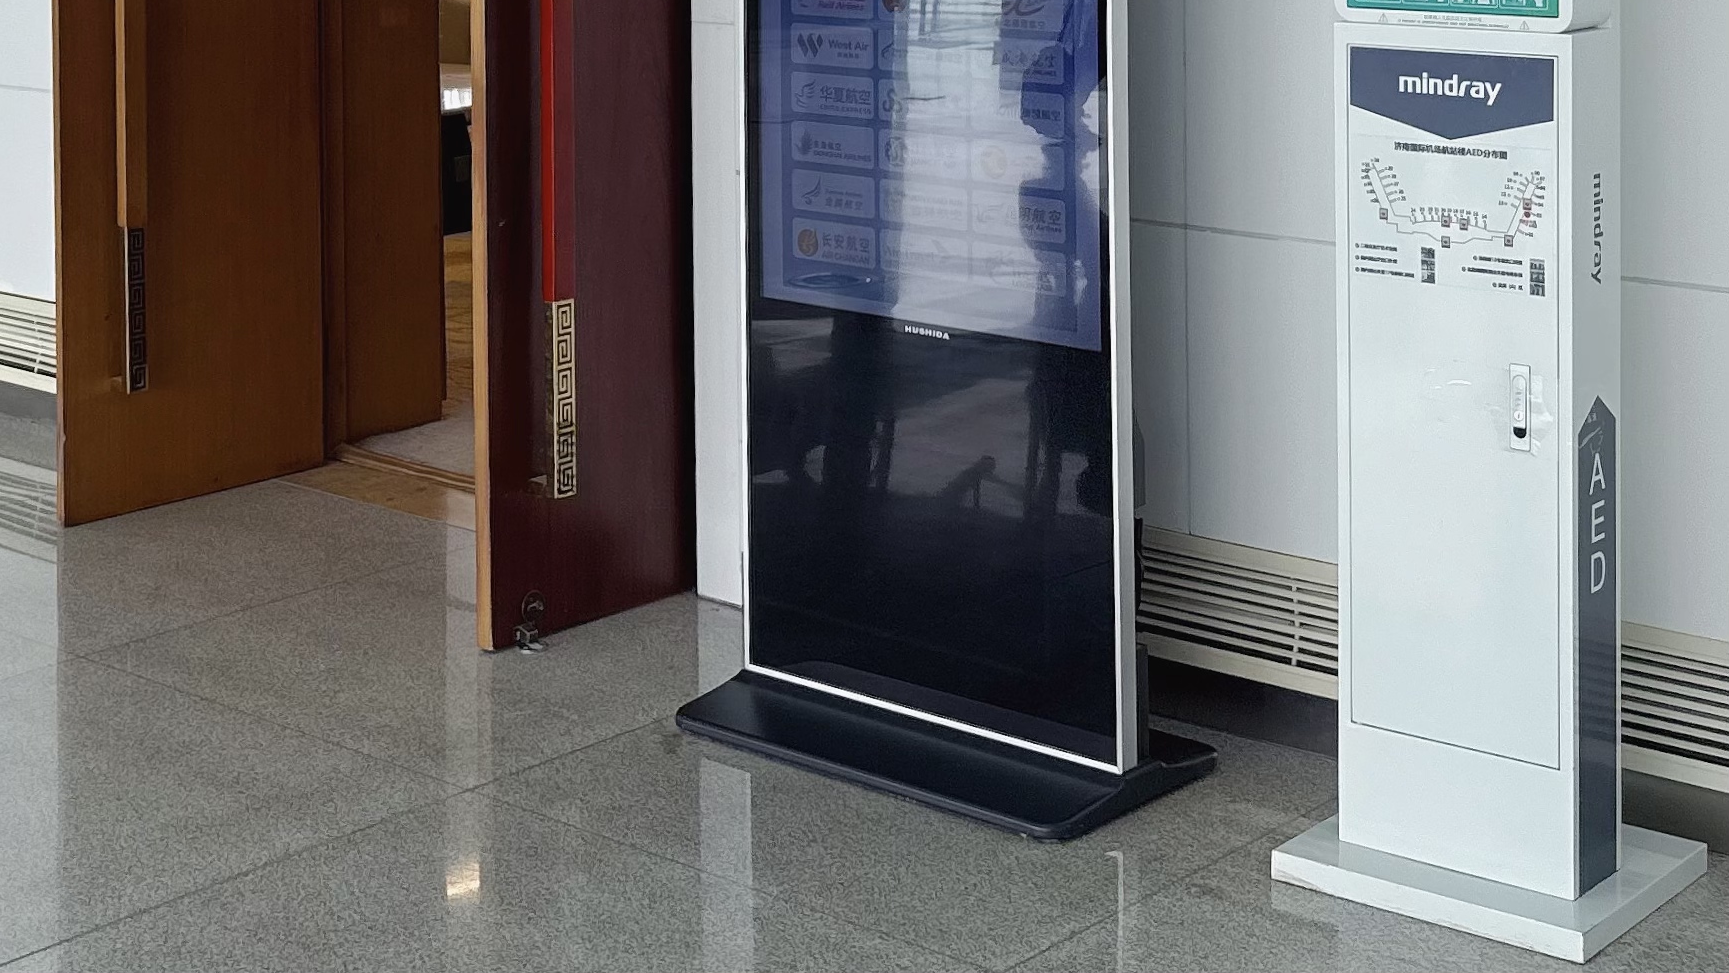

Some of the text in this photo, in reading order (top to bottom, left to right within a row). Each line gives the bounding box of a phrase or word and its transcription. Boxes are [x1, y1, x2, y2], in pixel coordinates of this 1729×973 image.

[827, 38, 869, 52] West Air
[819, 84, 872, 106] 华夏航空
[1398, 72, 1502, 106] mindray
[1590, 173, 1604, 284] mindray
[821, 231, 870, 254] 长安航空
[904, 324, 951, 341] HUSHIDA
[1589, 452, 1606, 594] AED
